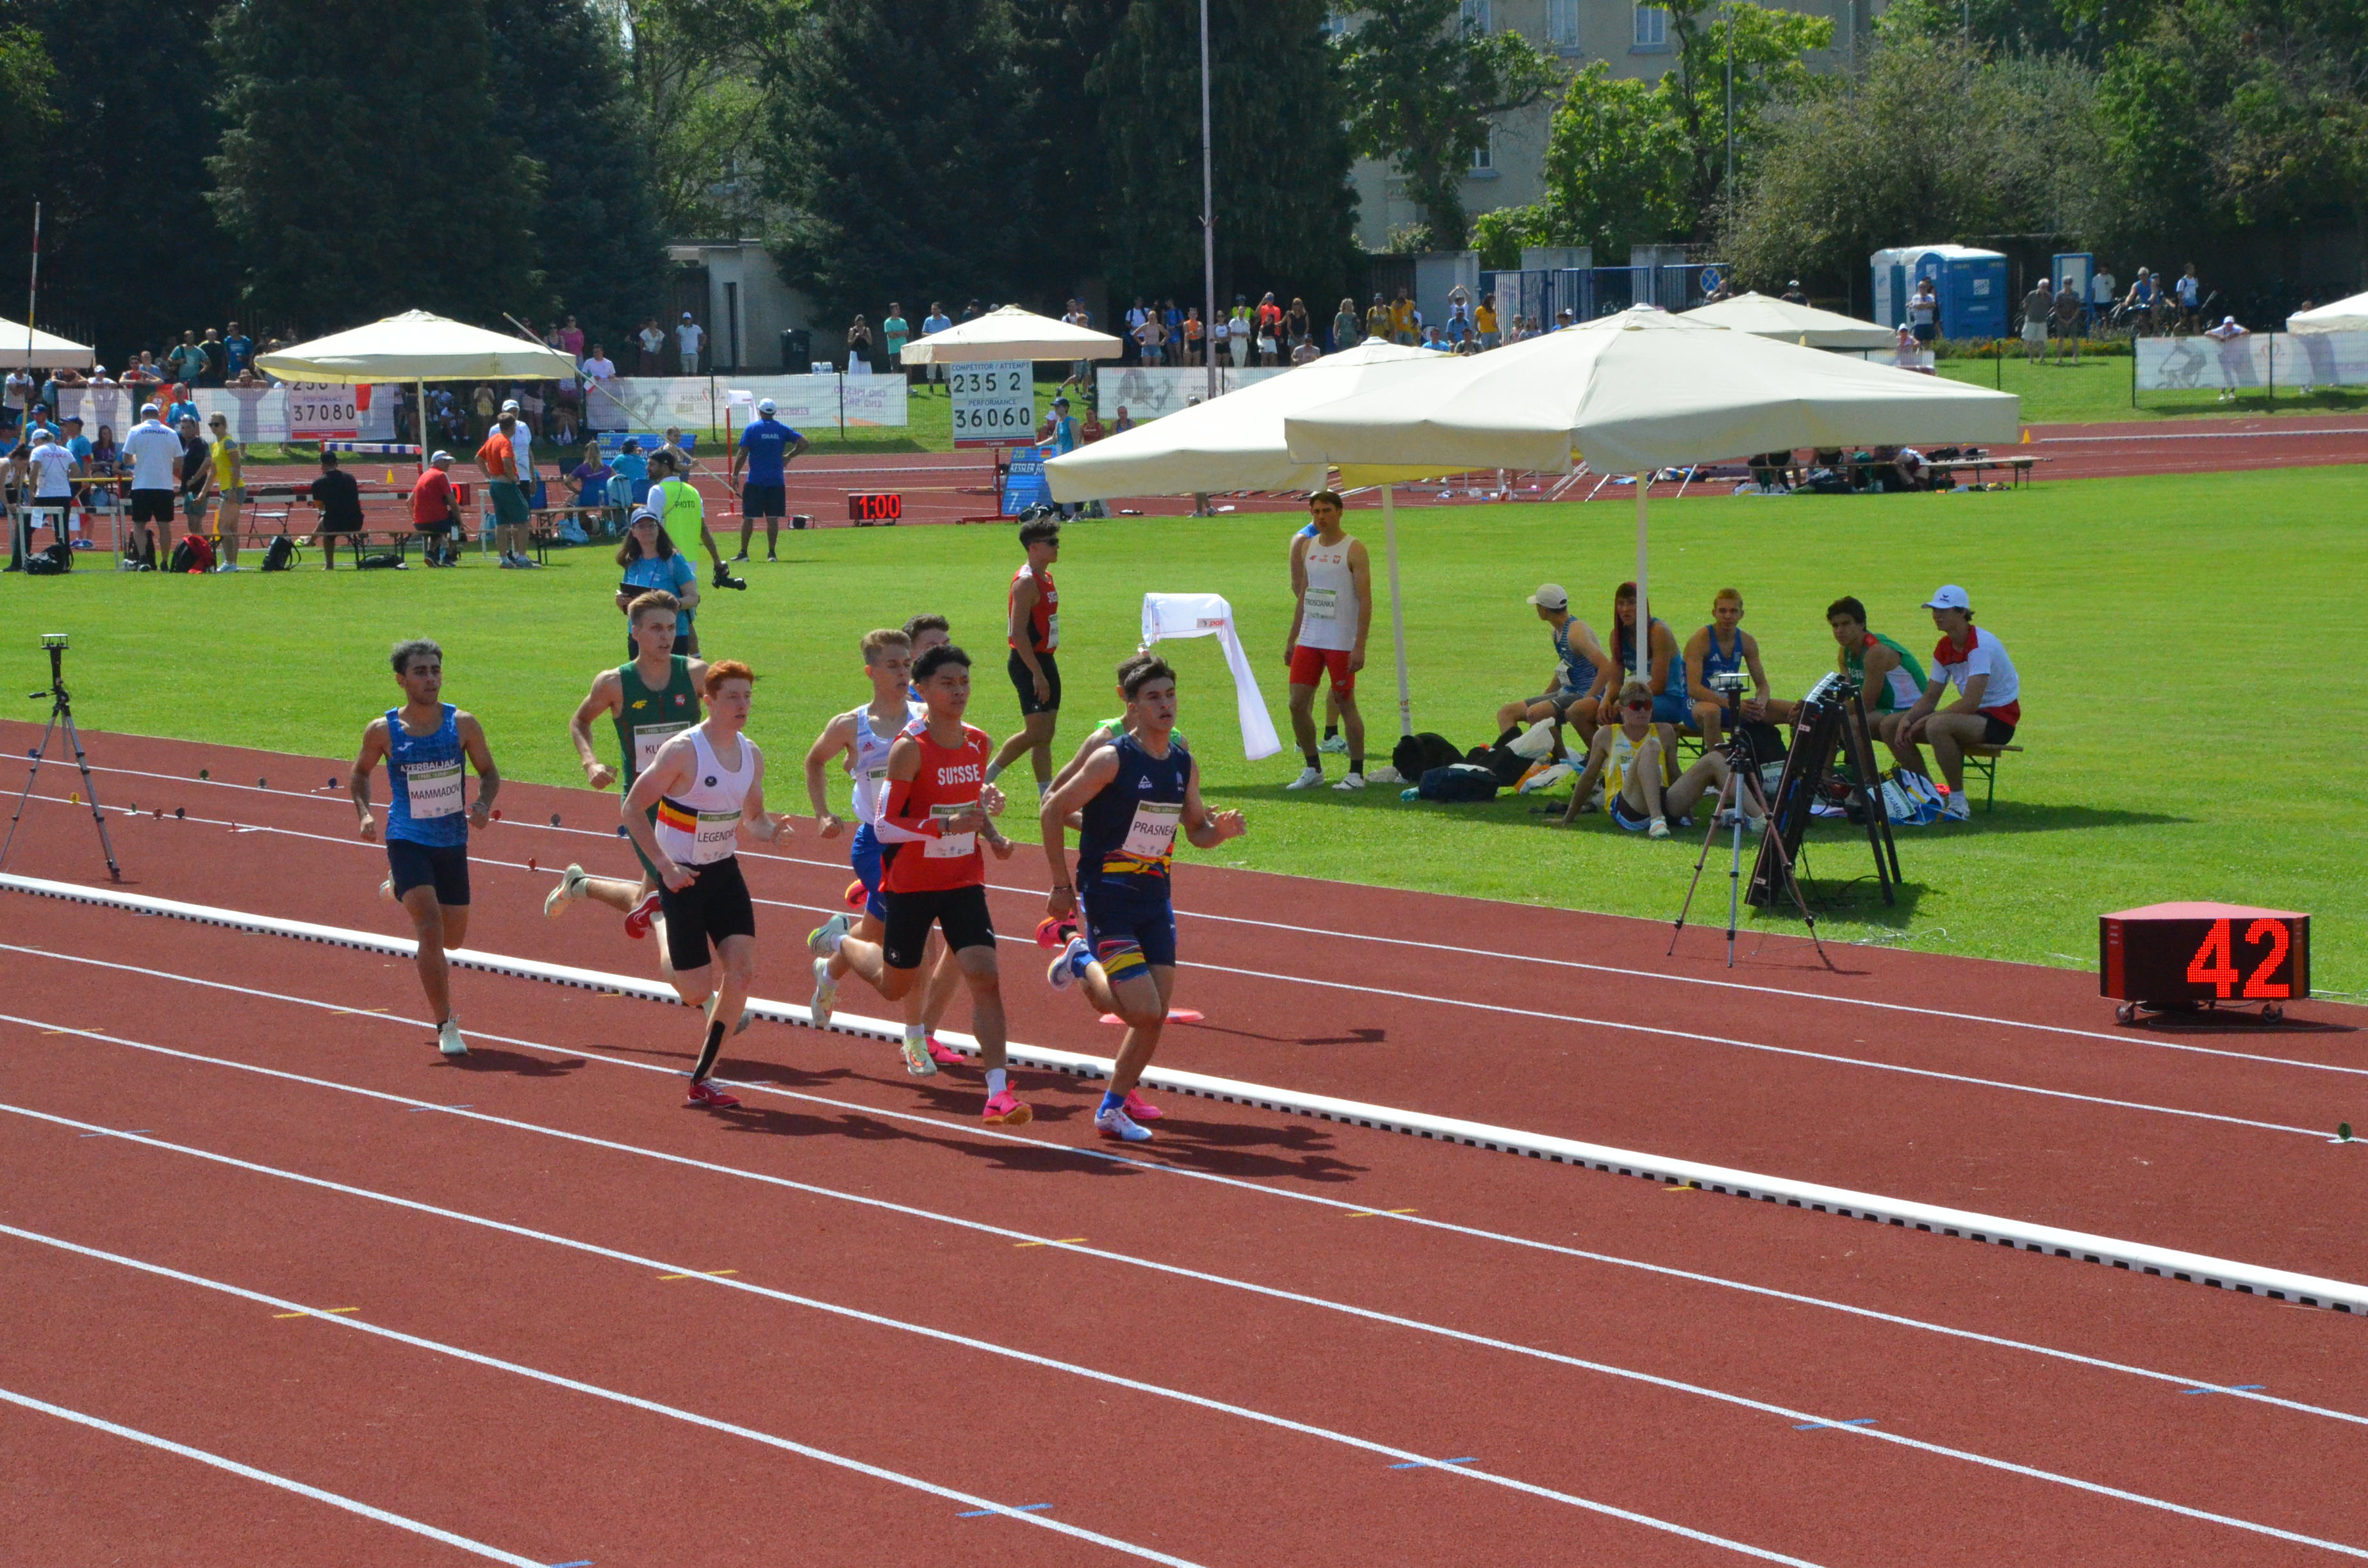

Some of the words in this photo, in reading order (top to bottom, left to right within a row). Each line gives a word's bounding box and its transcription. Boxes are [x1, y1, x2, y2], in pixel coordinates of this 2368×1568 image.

[953, 373, 997, 393] 235
[1009, 372, 1021, 391] 2
[1010, 463, 1035, 473] KESSLER
[859, 495, 901, 519] 1:00
[400, 758, 455, 772] AZERBAIJAN
[411, 783, 461, 800] MAMMADOV
[2187, 918, 2289, 998] 42
